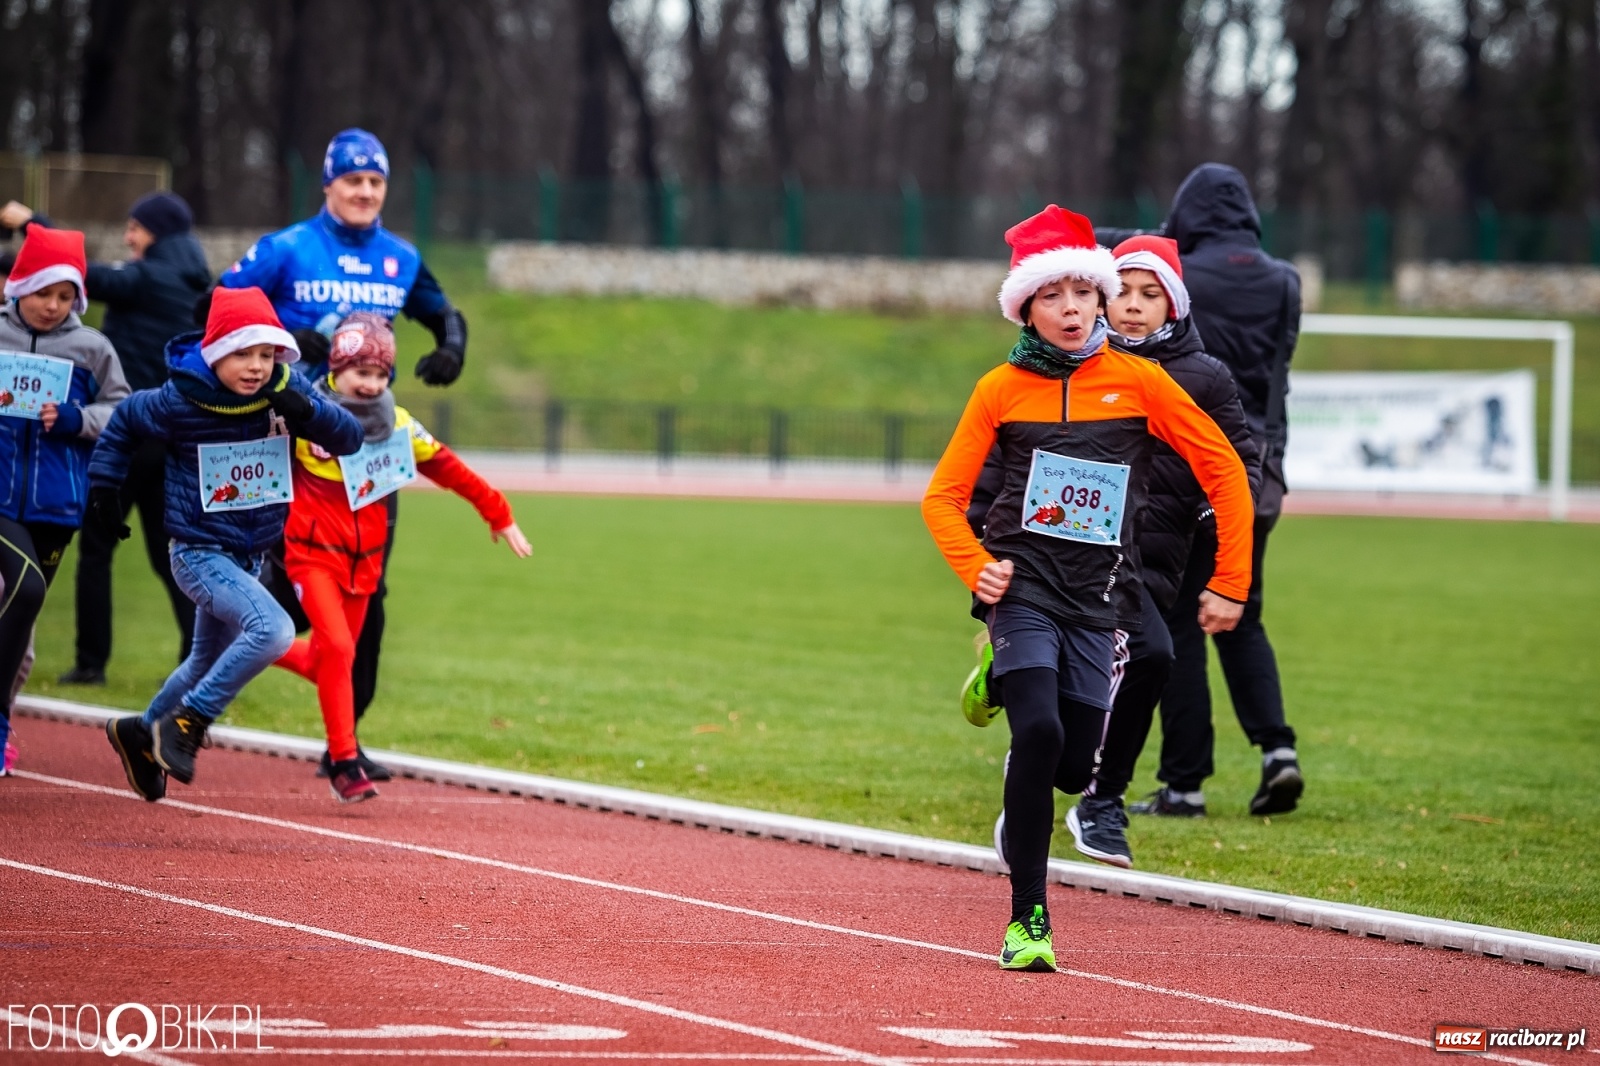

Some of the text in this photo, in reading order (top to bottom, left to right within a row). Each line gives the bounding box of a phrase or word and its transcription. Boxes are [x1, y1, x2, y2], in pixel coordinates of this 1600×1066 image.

[293, 279, 406, 308] RUNNERS
[1100, 393, 1121, 404] 4F
[230, 461, 265, 482] 060
[366, 453, 391, 476] 056
[1060, 484, 1102, 510] 038
